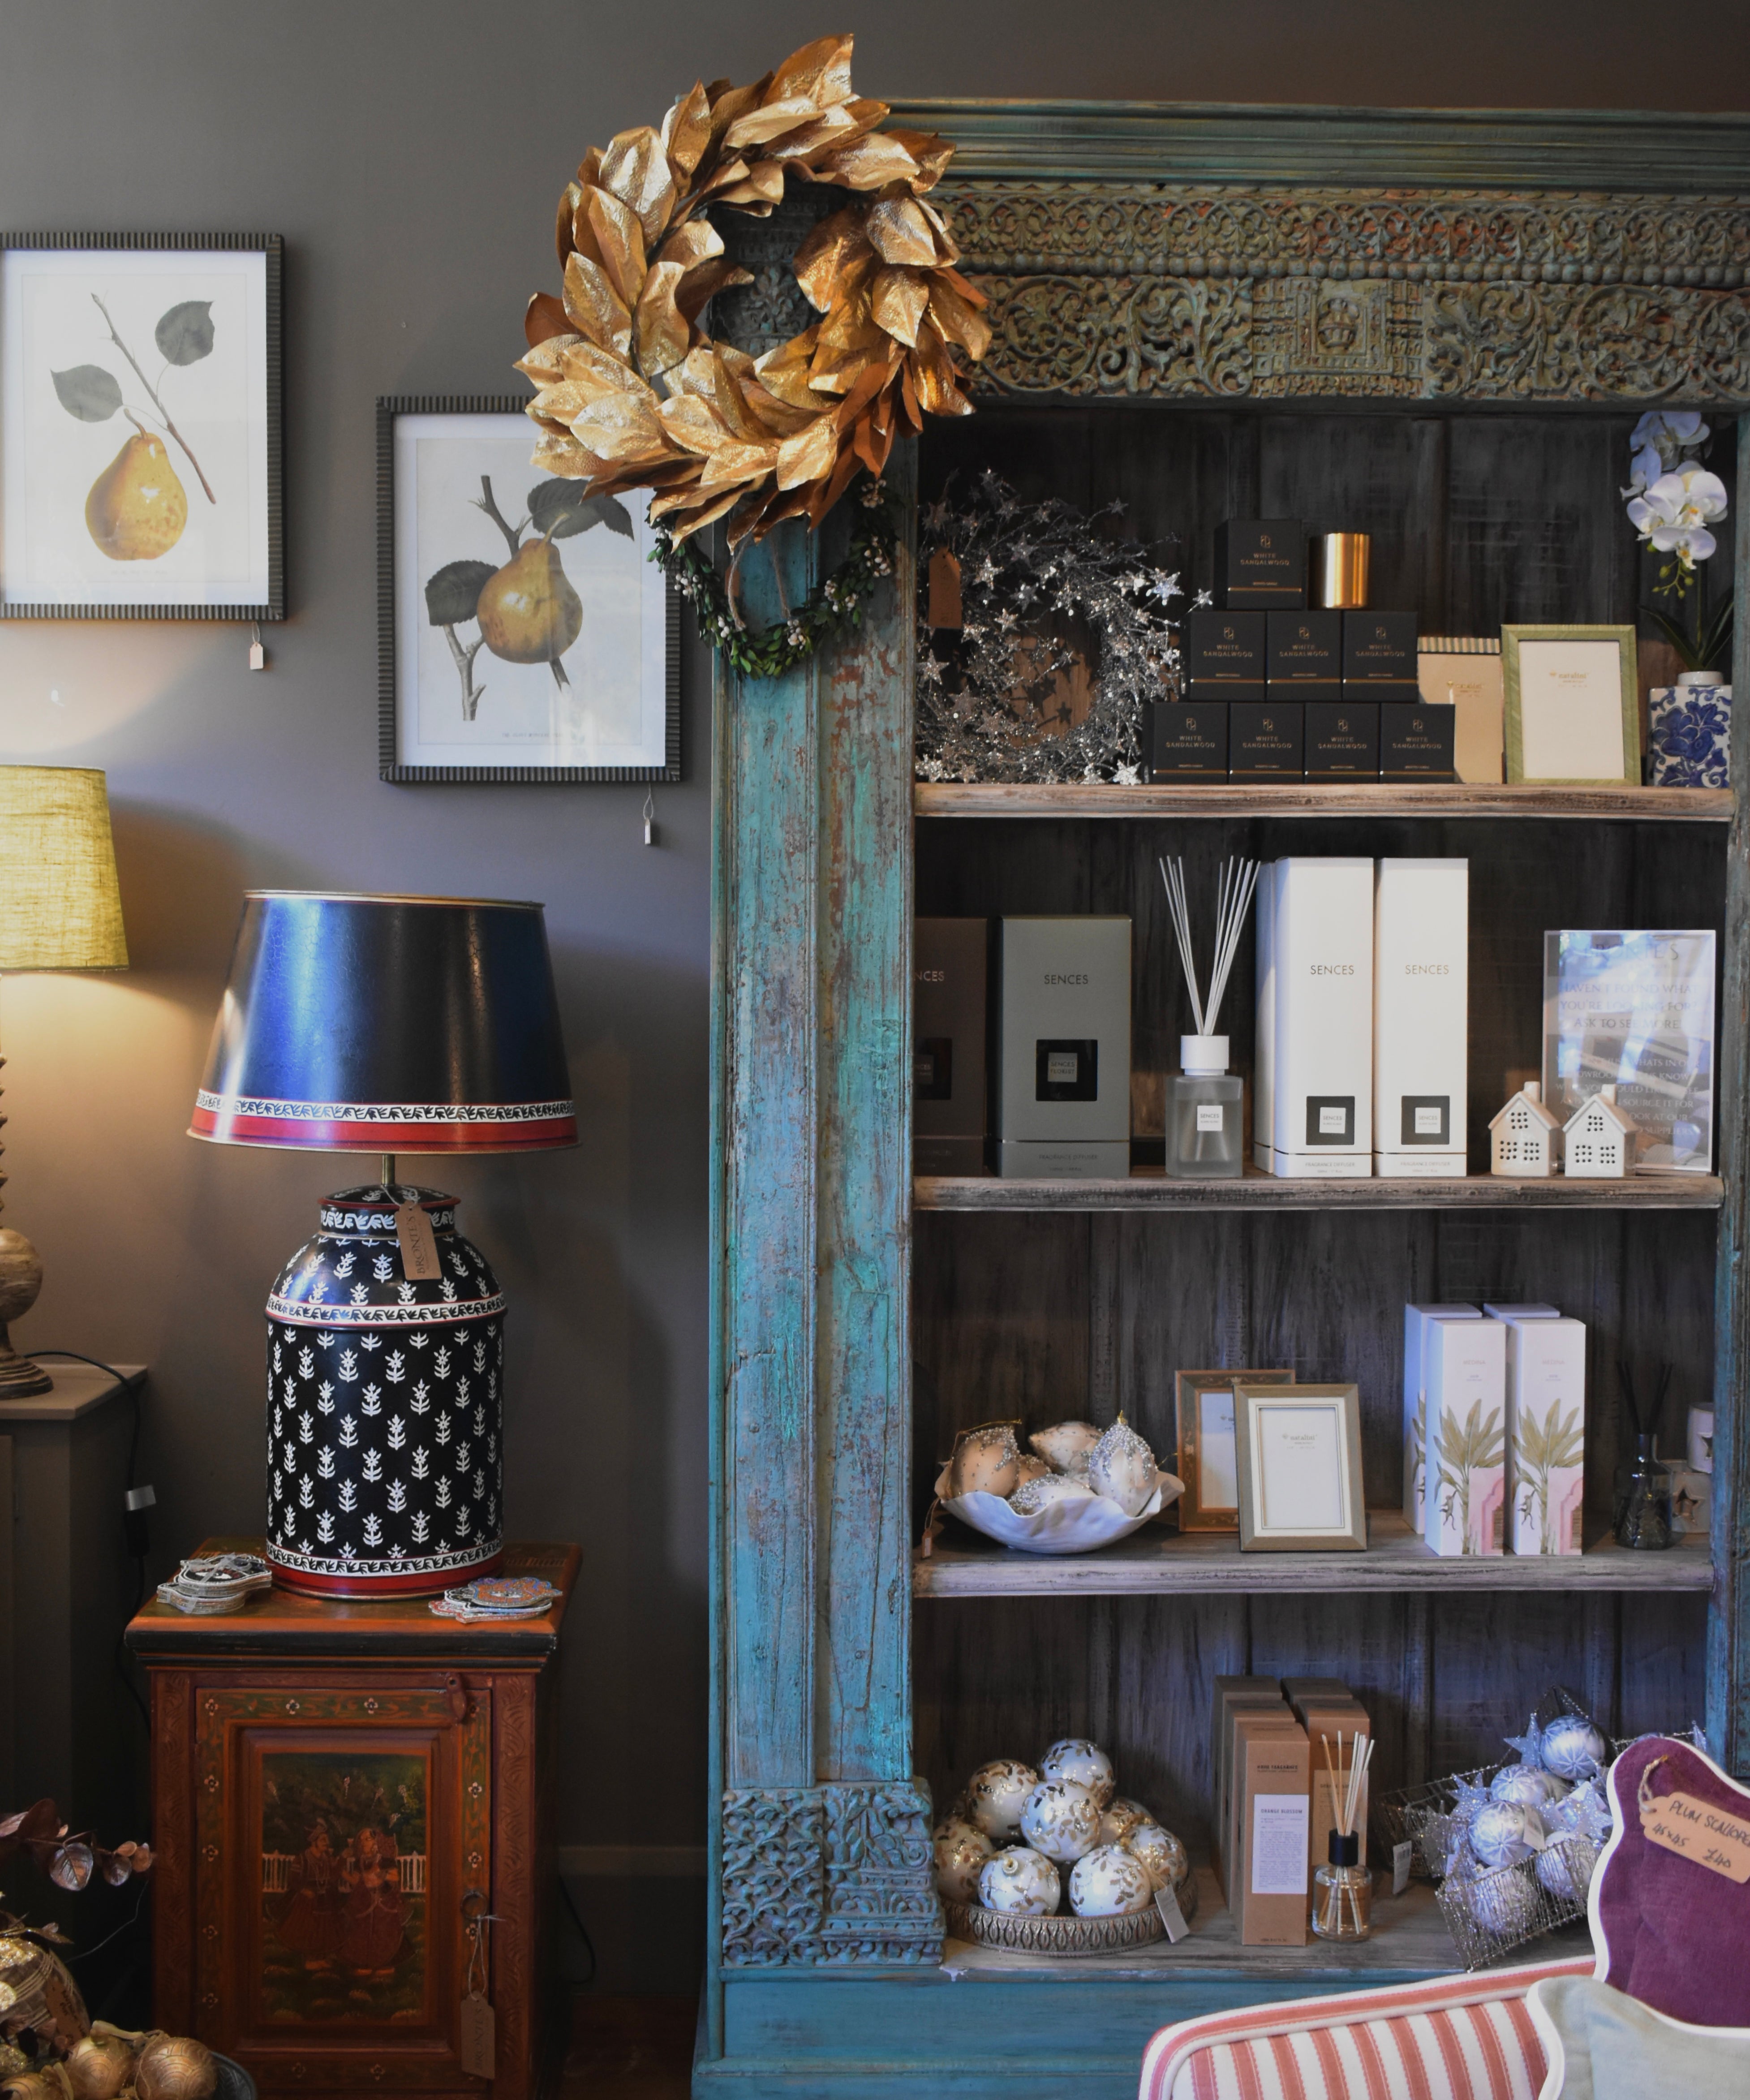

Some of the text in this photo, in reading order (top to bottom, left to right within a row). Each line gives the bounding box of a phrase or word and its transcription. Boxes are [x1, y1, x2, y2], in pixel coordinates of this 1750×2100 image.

[1310, 964, 1354, 976] SENCES
[1405, 964, 1449, 975] SENCES
[914, 971, 945, 982] NCES
[1044, 974, 1089, 985] SENCES
[1559, 984, 1698, 994] HAVENT FOUND WHAT
[1561, 999, 1602, 1011] YOU'RE
[1607, 1001, 1663, 1011] LOOING
[1574, 1018, 1595, 1028] ASK
[1600, 1019, 1616, 1028] TO
[1619, 1019, 1638, 1028] SEE
[1659, 1073, 1690, 1081] KNOW
[1618, 1085, 1643, 1094] OULD
[1622, 1098, 1660, 1107] SOURCE
[1629, 1112, 1650, 1120] OOK
[406, 1216, 425, 1274] BRONTE'S
[1668, 1800, 1750, 1847] PLUM SCALLOPE
[1703, 1848, 1732, 1868] £40
[473, 2008, 484, 2069] BRONTES
